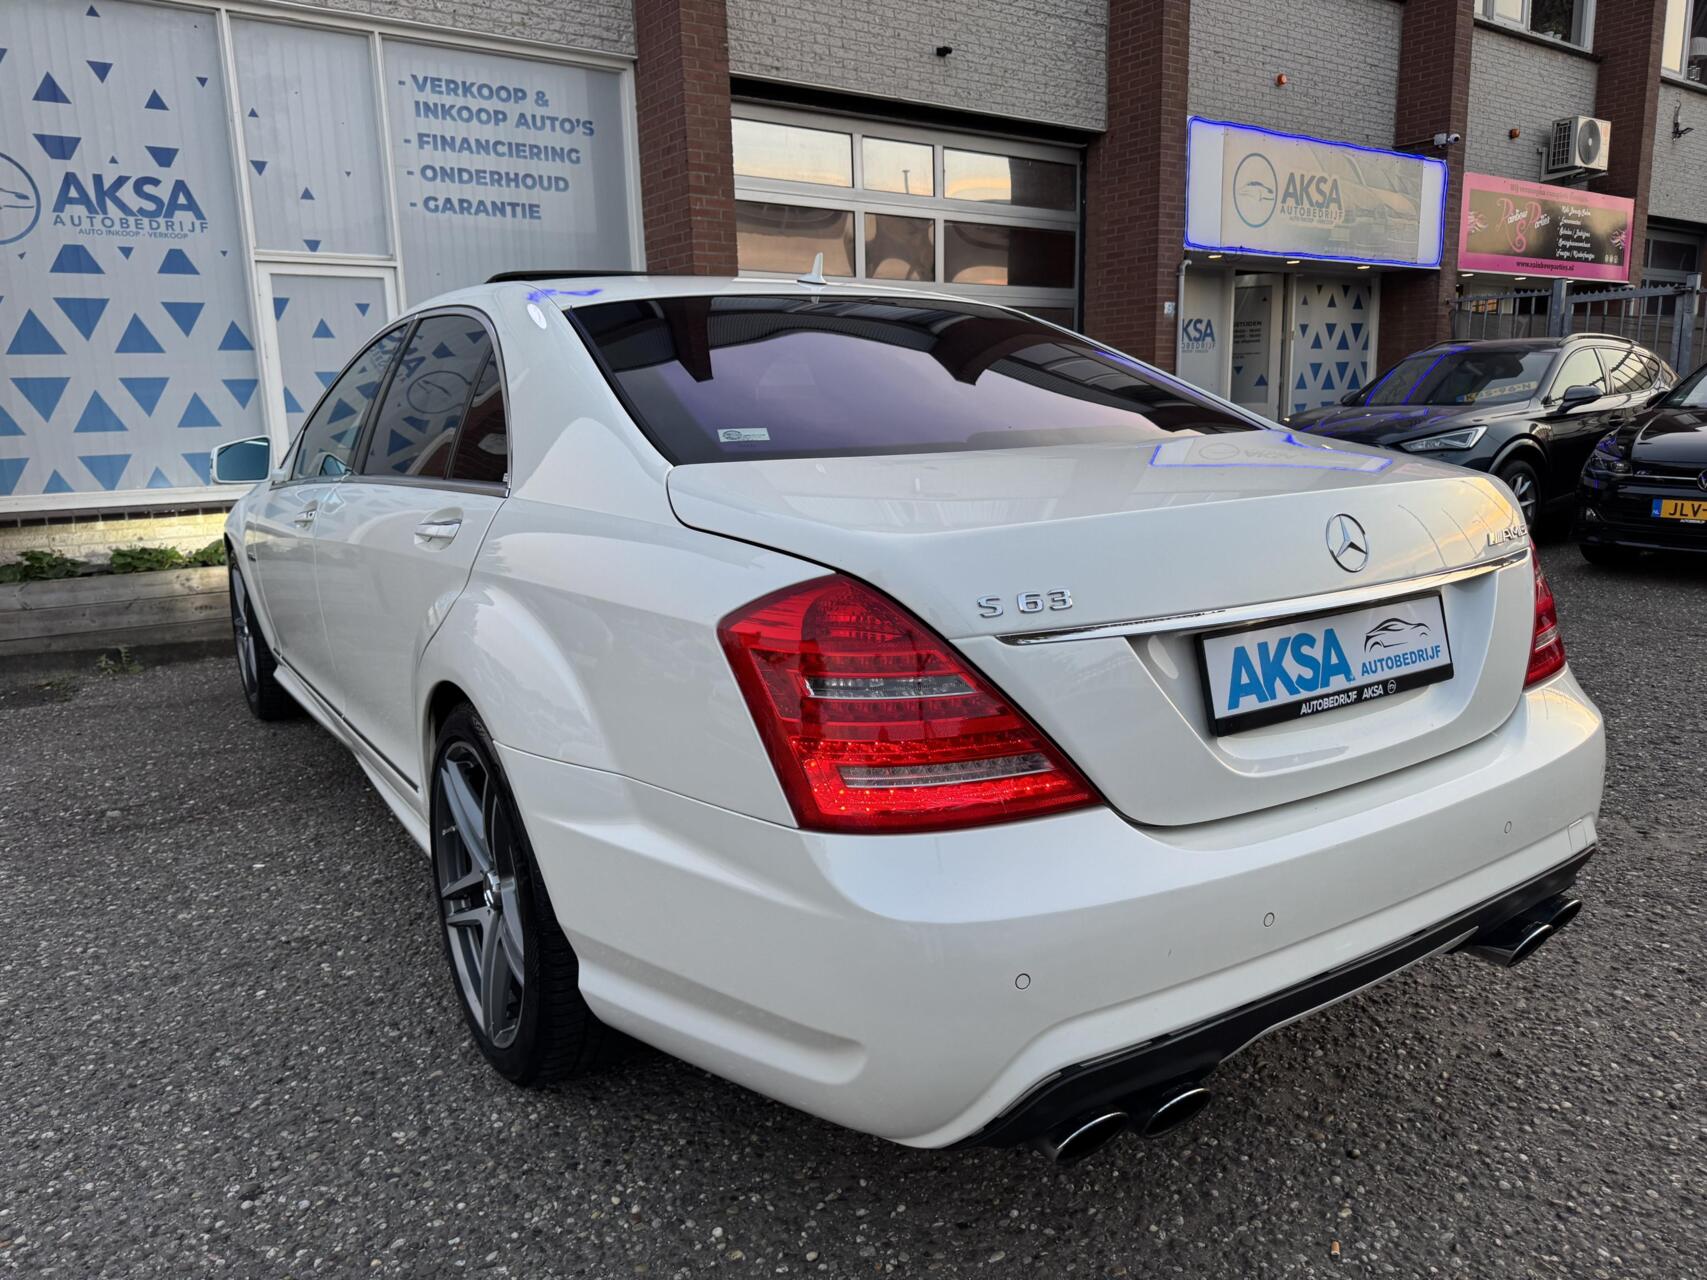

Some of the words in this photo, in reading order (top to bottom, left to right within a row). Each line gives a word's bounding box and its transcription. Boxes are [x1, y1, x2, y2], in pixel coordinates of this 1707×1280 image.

[410, 74, 527, 104] VERKOOP
[534, 90, 549, 108] &
[414, 100, 508, 127] INKOOP
[515, 112, 595, 137] AUTO'S
[417, 133, 581, 165] FINANCIERING
[420, 164, 569, 193] ONDERHOUD
[1281, 171, 1343, 210] AKSA
[52, 171, 207, 221] AKSA
[423, 195, 542, 220] GARANTIE
[53, 214, 208, 233] AUTOBEDRIJF
[1280, 205, 1344, 220] AUTOBEDRIJF
[78, 228, 102, 236] AUTO
[106, 229, 140, 237] INKOOP
[148, 231, 188, 240] VERKOOP
[1181, 318, 1215, 342] KSA
[977, 595, 1003, 618] S
[1017, 588, 1073, 614] 63
[1228, 628, 1352, 711] AKSA
[1361, 645, 1441, 677] AUTOBEDRIJF
[1300, 691, 1358, 715] AUTOBEDRIJF
[1362, 684, 1384, 700] AKSA
